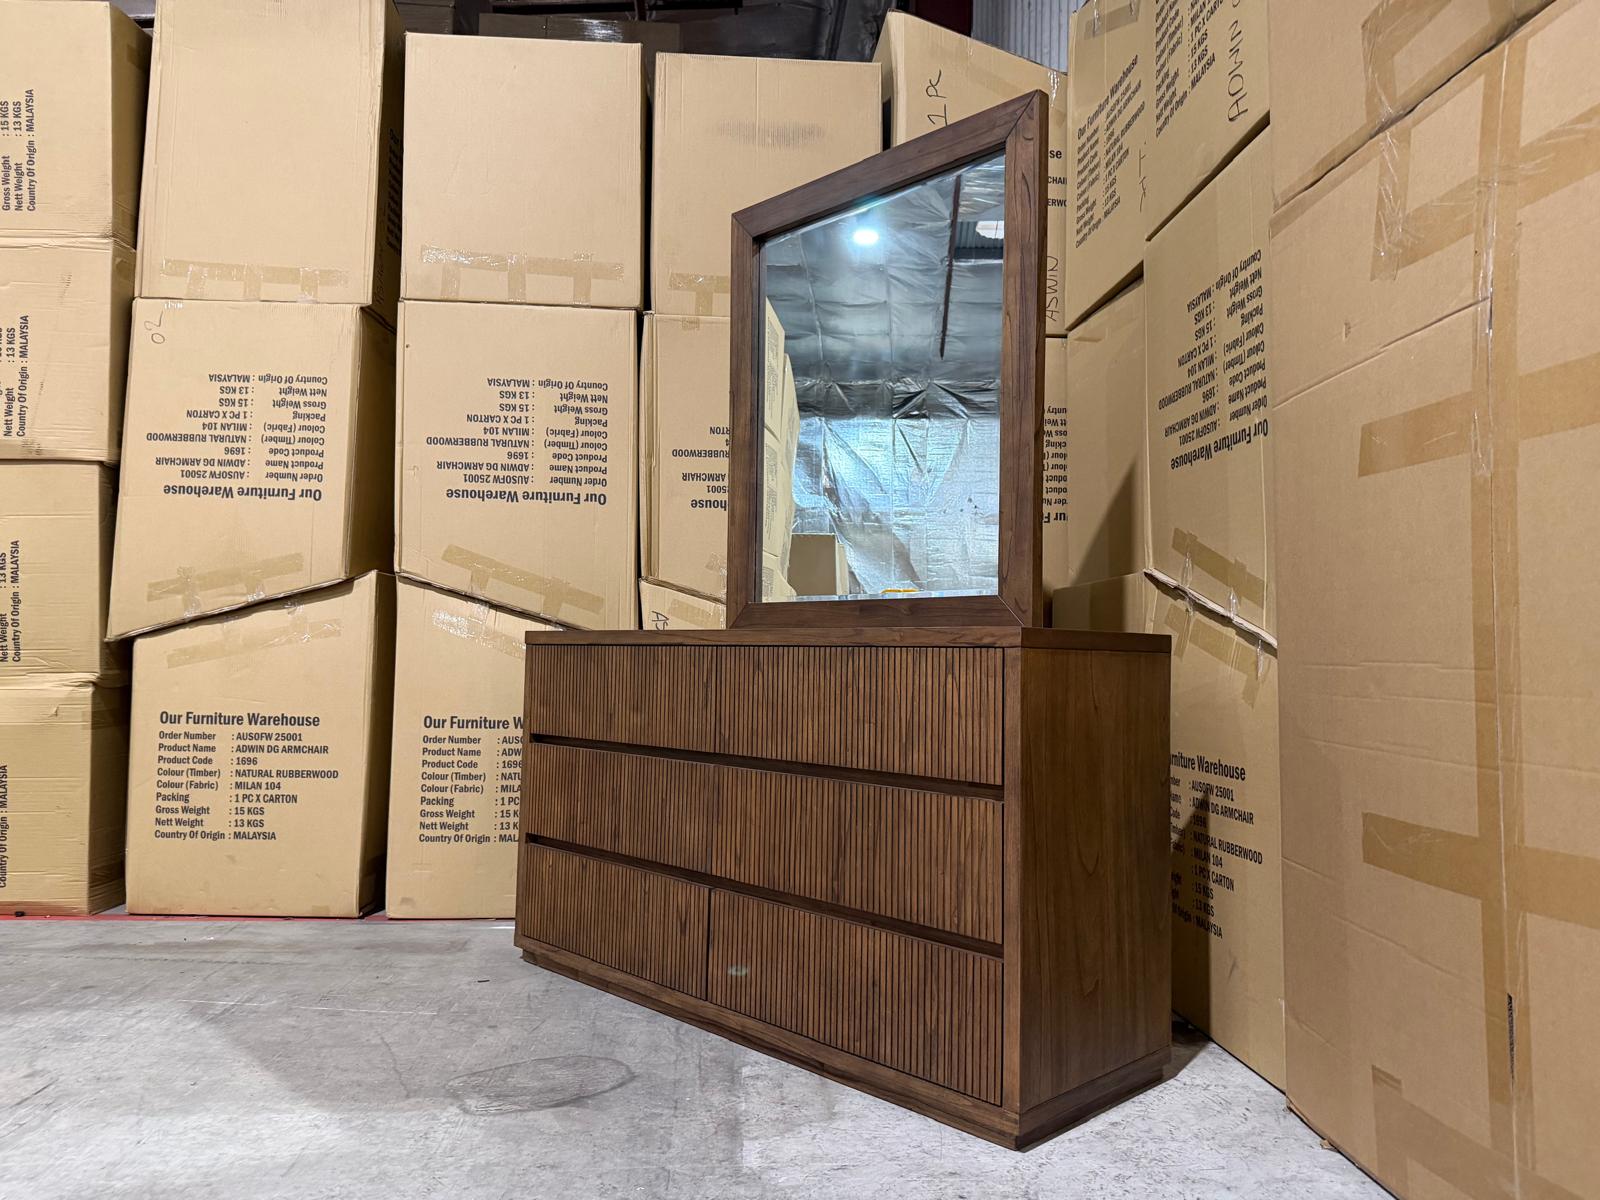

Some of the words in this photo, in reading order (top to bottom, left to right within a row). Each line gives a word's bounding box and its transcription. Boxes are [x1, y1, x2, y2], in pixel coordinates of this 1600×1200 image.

[13, 101, 21, 118] KGS
[25, 89, 34, 132] MALAYSIA
[1, 120, 9, 131] 15
[14, 121, 22, 131] 13
[27, 140, 37, 165] Origin
[2, 156, 12, 186] Weight
[27, 167, 35, 177] Of
[14, 163, 24, 192] Weight
[2, 187, 10, 211] Gross
[27, 179, 37, 211] Country
[14, 193, 23, 211] Nett
[1239, 249, 1261, 273] Country
[1232, 266, 1238, 281] Of
[1216, 272, 1231, 291] Origin
[1187, 286, 1212, 313] MALAYSIA
[19, 315, 29, 358] MALAYSIA
[1246, 340, 1264, 359] Colour
[1223, 349, 1246, 374] (Timber)
[19, 366, 29, 391] Origin
[1192, 369, 1215, 391] NATURAL
[18, 393, 26, 402] Of
[1158, 382, 1192, 410] RUBBERWOOD
[499, 403, 516, 412] KGS
[518, 403, 529, 412] 15
[554, 403, 583, 414] Weight
[584, 406, 608, 416] Gross
[17, 404, 28, 436] Country
[466, 414, 501, 424] CARTON
[503, 415, 509, 424] X
[510, 415, 522, 424] PC
[524, 416, 529, 424] 1
[574, 416, 608, 428] Packing
[483, 426, 499, 435] 104
[502, 427, 530, 436] MILAN
[546, 427, 579, 438] (Fabric)
[1253, 418, 1268, 437] Our
[146, 432, 207, 443] RUBBERWOOD
[208, 434, 247, 444] NATURAL
[261, 434, 296, 445] (Timber)
[580, 430, 608, 440] Colour
[1214, 426, 1252, 453] Furniture
[297, 437, 325, 446] Colour
[507, 451, 528, 460] 1696
[552, 452, 574, 462] Code
[575, 453, 607, 463] Product
[1171, 443, 1212, 470] Warehouse
[155, 457, 202, 466] ARMCHAIR
[203, 458, 215, 467] DG
[217, 458, 246, 468] ADWIN
[265, 460, 289, 469] Name
[291, 460, 324, 470] Product
[180, 469, 208, 479] 25001
[208, 470, 245, 480] AUSOFW
[265, 472, 298, 482] Number
[299, 473, 323, 483] Order
[682, 472, 726, 481] ARMCHAIR
[163, 485, 234, 499] Warehouse
[237, 487, 296, 501] Furniture
[707, 485, 729, 493] 5001
[299, 489, 322, 501] Our
[446, 489, 519, 503] Warehouse
[522, 491, 580, 505] Furniture
[584, 493, 606, 505] Our
[691, 499, 726, 511] house
[10, 540, 19, 583] MALAYSIA
[11, 592, 21, 616] Origin
[12, 618, 19, 628] Of
[12, 629, 21, 662] Country
[160, 711, 183, 724] Our
[186, 712, 244, 726] Furniture
[247, 713, 320, 726] Warehouse
[424, 716, 447, 728] Our
[450, 716, 510, 730] Furniture
[159, 730, 183, 740] Order
[183, 731, 216, 740] Number
[236, 732, 274, 741] AUSOFW
[274, 732, 303, 742] 25001
[422, 735, 447, 744] Order
[448, 735, 481, 744] Number
[158, 743, 191, 752] Product
[192, 744, 216, 752] Name
[235, 744, 265, 753] ADWIN
[266, 744, 280, 754] DG
[281, 745, 329, 754] ARMCHAIR
[422, 747, 456, 756] Product
[457, 748, 481, 756] Name
[157, 755, 190, 764] Product
[192, 756, 213, 764] Code
[236, 756, 258, 766] 1696
[422, 760, 455, 768] Product
[456, 760, 478, 768] Code
[157, 768, 185, 776] Colour
[186, 768, 221, 779] (Timber)
[235, 769, 274, 778] NATURAL
[276, 769, 339, 779] RUBBERWOOD
[1197, 755, 1245, 782] Warehouse
[421, 772, 449, 780] Colour
[451, 772, 486, 782] (Timber)
[156, 780, 184, 788] Colour
[185, 780, 219, 791] (Fabric)
[234, 781, 262, 790] MILAN
[265, 782, 281, 790] 104
[420, 784, 449, 792] Colour
[450, 784, 484, 795] (Fabric)
[156, 792, 190, 804] Packing
[234, 793, 240, 803] 1
[242, 794, 254, 803] PC
[255, 794, 261, 803] X
[262, 794, 298, 804] CARTON
[1215, 786, 1234, 801] 25001
[420, 796, 455, 808] Packing
[500, 797, 506, 806] 1
[508, 796, 520, 806] PC
[155, 805, 179, 814] Gross
[181, 805, 210, 816] Weight
[234, 806, 245, 815] 15
[247, 806, 265, 816] KGS
[420, 809, 444, 818] Gross
[445, 809, 475, 820] Weight
[500, 810, 511, 818] 15
[1211, 802, 1219, 815] DG
[1220, 805, 1253, 826] ARMCHAIR
[155, 817, 173, 826] Nett
[174, 818, 204, 828] Weight
[234, 818, 245, 828] 13
[247, 819, 264, 828] KGS
[154, 830, 188, 840] Country
[189, 830, 199, 839] Of
[200, 830, 225, 841] Origin
[233, 831, 276, 840] MALAYSIA
[419, 834, 452, 844] Country
[453, 834, 464, 842] Of
[465, 834, 491, 844] Origin
[1218, 839, 1263, 866] RUBBERWOOD
[1212, 854, 1223, 869] 104
[1211, 870, 1234, 892] CARTON
